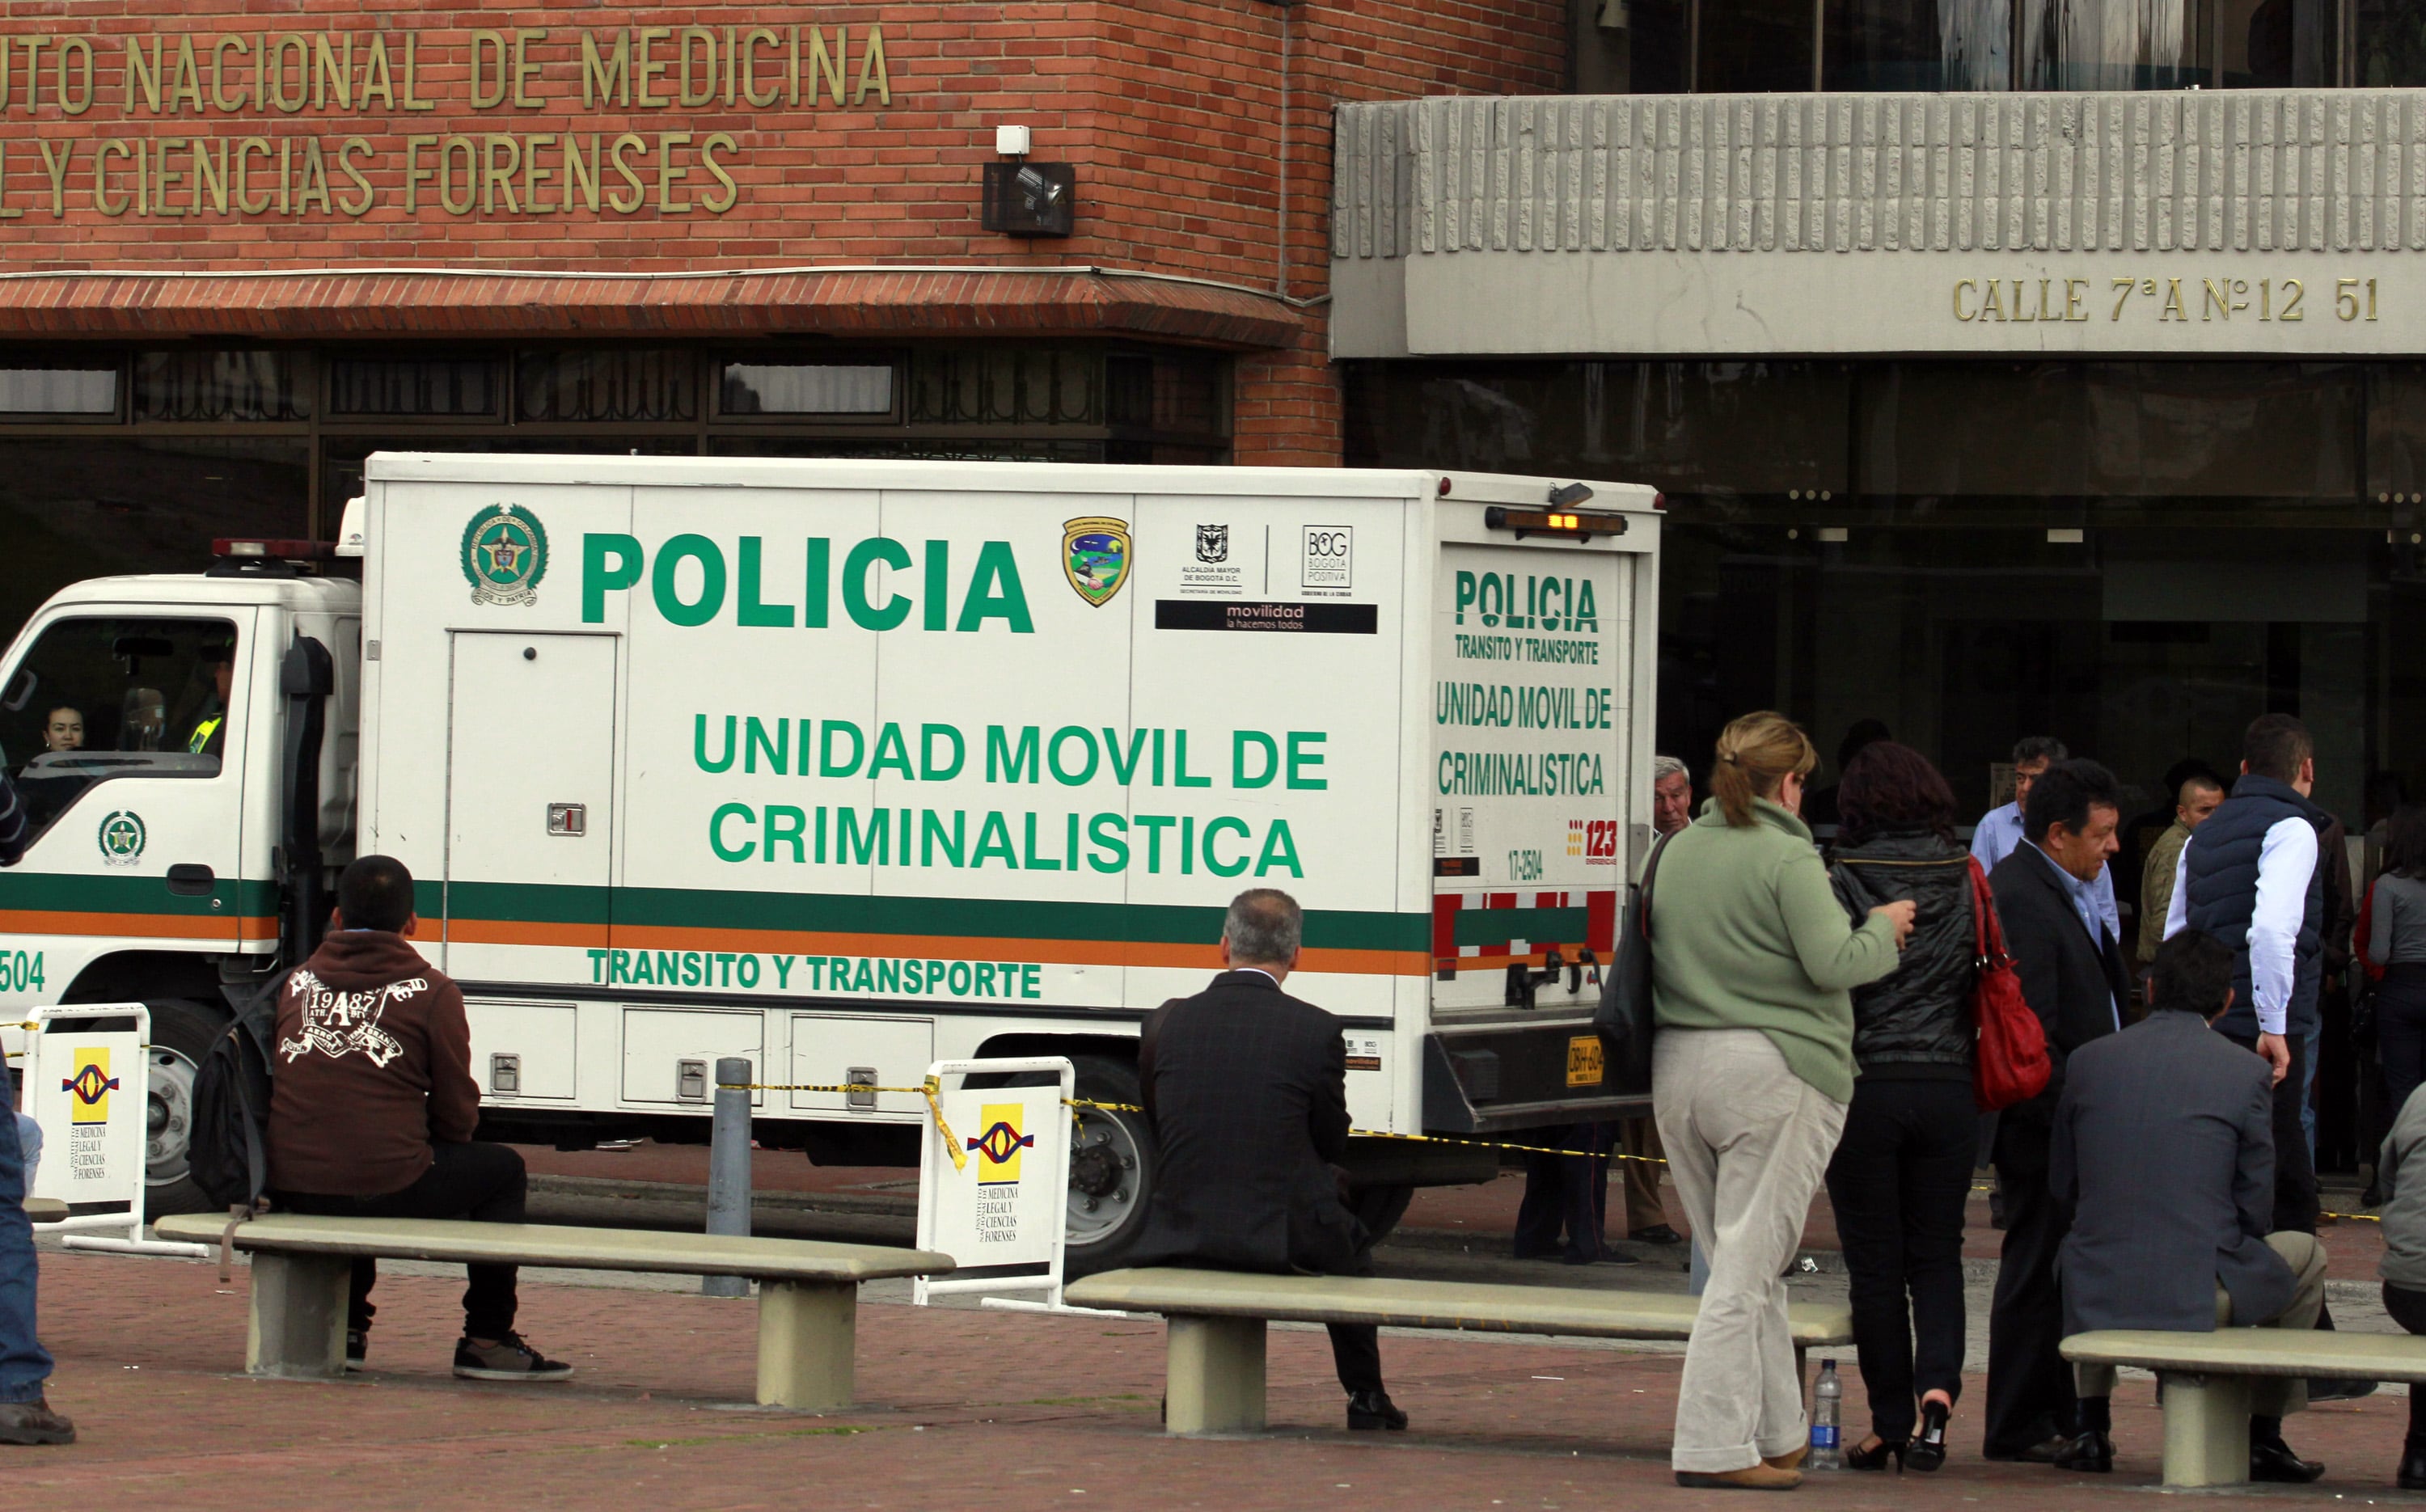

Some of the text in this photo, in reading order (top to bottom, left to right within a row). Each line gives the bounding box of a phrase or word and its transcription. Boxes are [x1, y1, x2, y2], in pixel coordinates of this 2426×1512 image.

[0, 25, 891, 115] TO NACIONAL DE MEDICINA
[40, 139, 75, 218] Y
[95, 136, 375, 217] CIENCIAS
[407, 133, 738, 215] FORENSES
[1953, 278, 2090, 322] CALLE
[2335, 277, 2378, 322] 51
[1308, 532, 1347, 557] BOG
[581, 533, 1035, 634] POLICIA
[1308, 571, 1346, 582] POSITIVA
[506, 590, 532, 603] PATRIA
[1456, 571, 1598, 633] POLICIA
[1227, 604, 1304, 619] movilidad
[1227, 619, 1304, 630] la hacemos todos
[1456, 634, 1599, 665] TRANSITO Y TRANSPORTE
[1437, 682, 1611, 729] UNIDAD MOVIL DE
[694, 714, 1328, 791] UNIDAD MOVIL DE
[1439, 751, 1604, 796] CRIMINALISTICA
[709, 802, 1304, 879] CRIMINALISTICA
[1586, 820, 1617, 857] 123
[1508, 850, 1543, 881] 17-2504
[586, 949, 1042, 999] TRANSITO Y TRANSPORTE
[306, 1027, 333, 1041] AERO
[366, 1028, 396, 1049] BRAND
[80, 1126, 106, 1138] MEDICINA
[79, 1140, 102, 1152] LEGAL Y
[78, 1153, 105, 1166] CIENCIAS
[78, 1167, 105, 1180] FORENSES
[987, 1187, 1018, 1199] MEDICINA
[987, 1202, 1012, 1214] LEGAL Y
[986, 1215, 1017, 1228] CIENCIAS
[985, 1229, 1016, 1243] FORENSES
